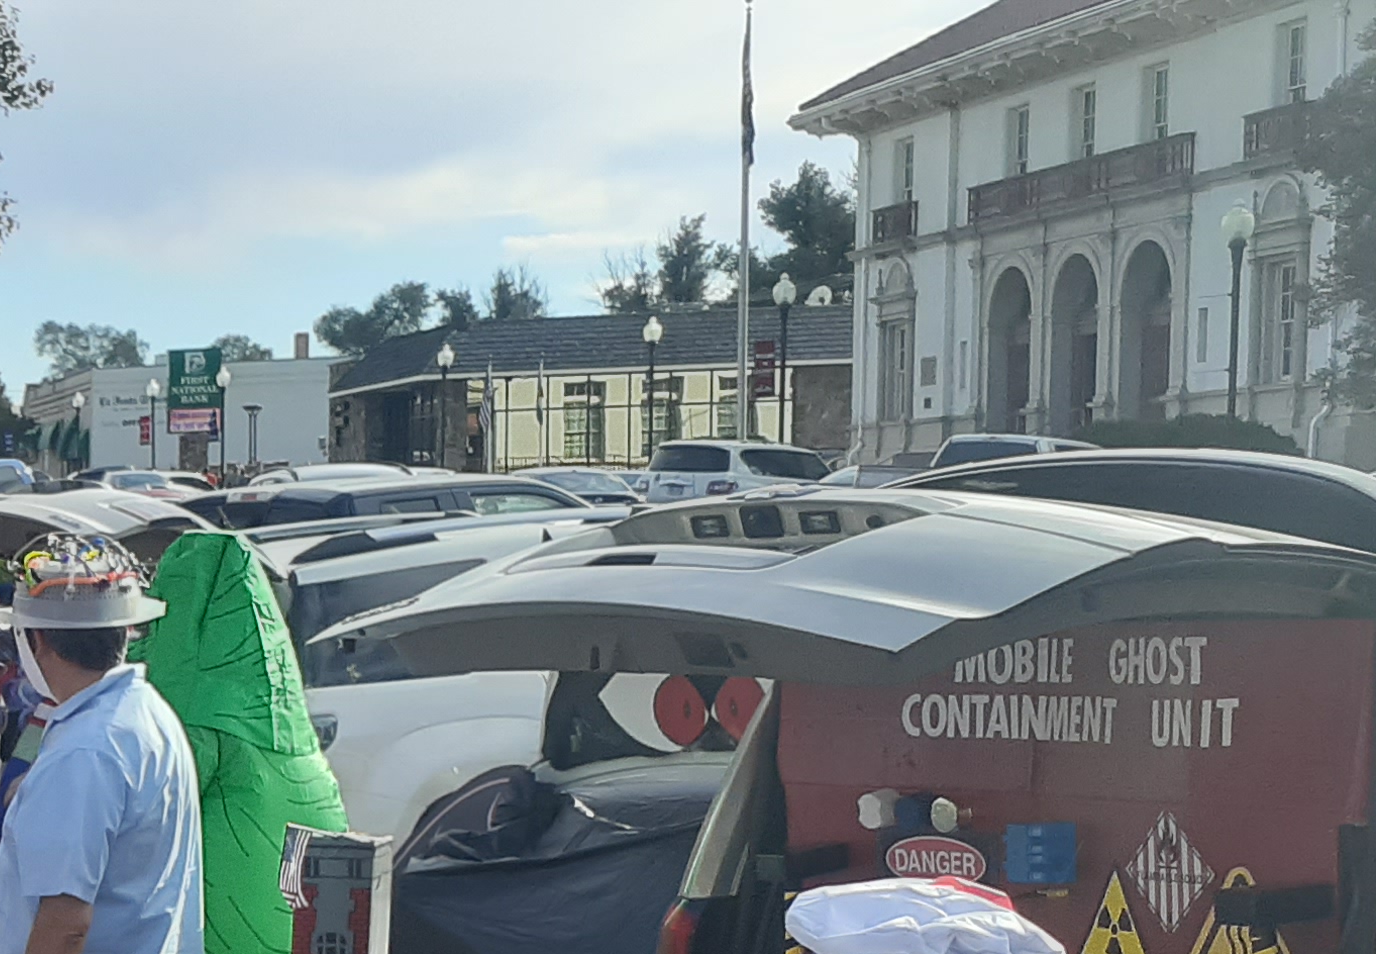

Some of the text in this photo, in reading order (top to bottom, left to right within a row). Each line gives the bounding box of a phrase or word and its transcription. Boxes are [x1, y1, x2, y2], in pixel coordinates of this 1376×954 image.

[171, 385, 219, 395] NATIONAL
[180, 376, 209, 385] FIRST
[954, 636, 1207, 685] MOBILE GHOST
[902, 693, 1240, 748] CONTAINMENT UNIT
[894, 849, 976, 877] DANGER
